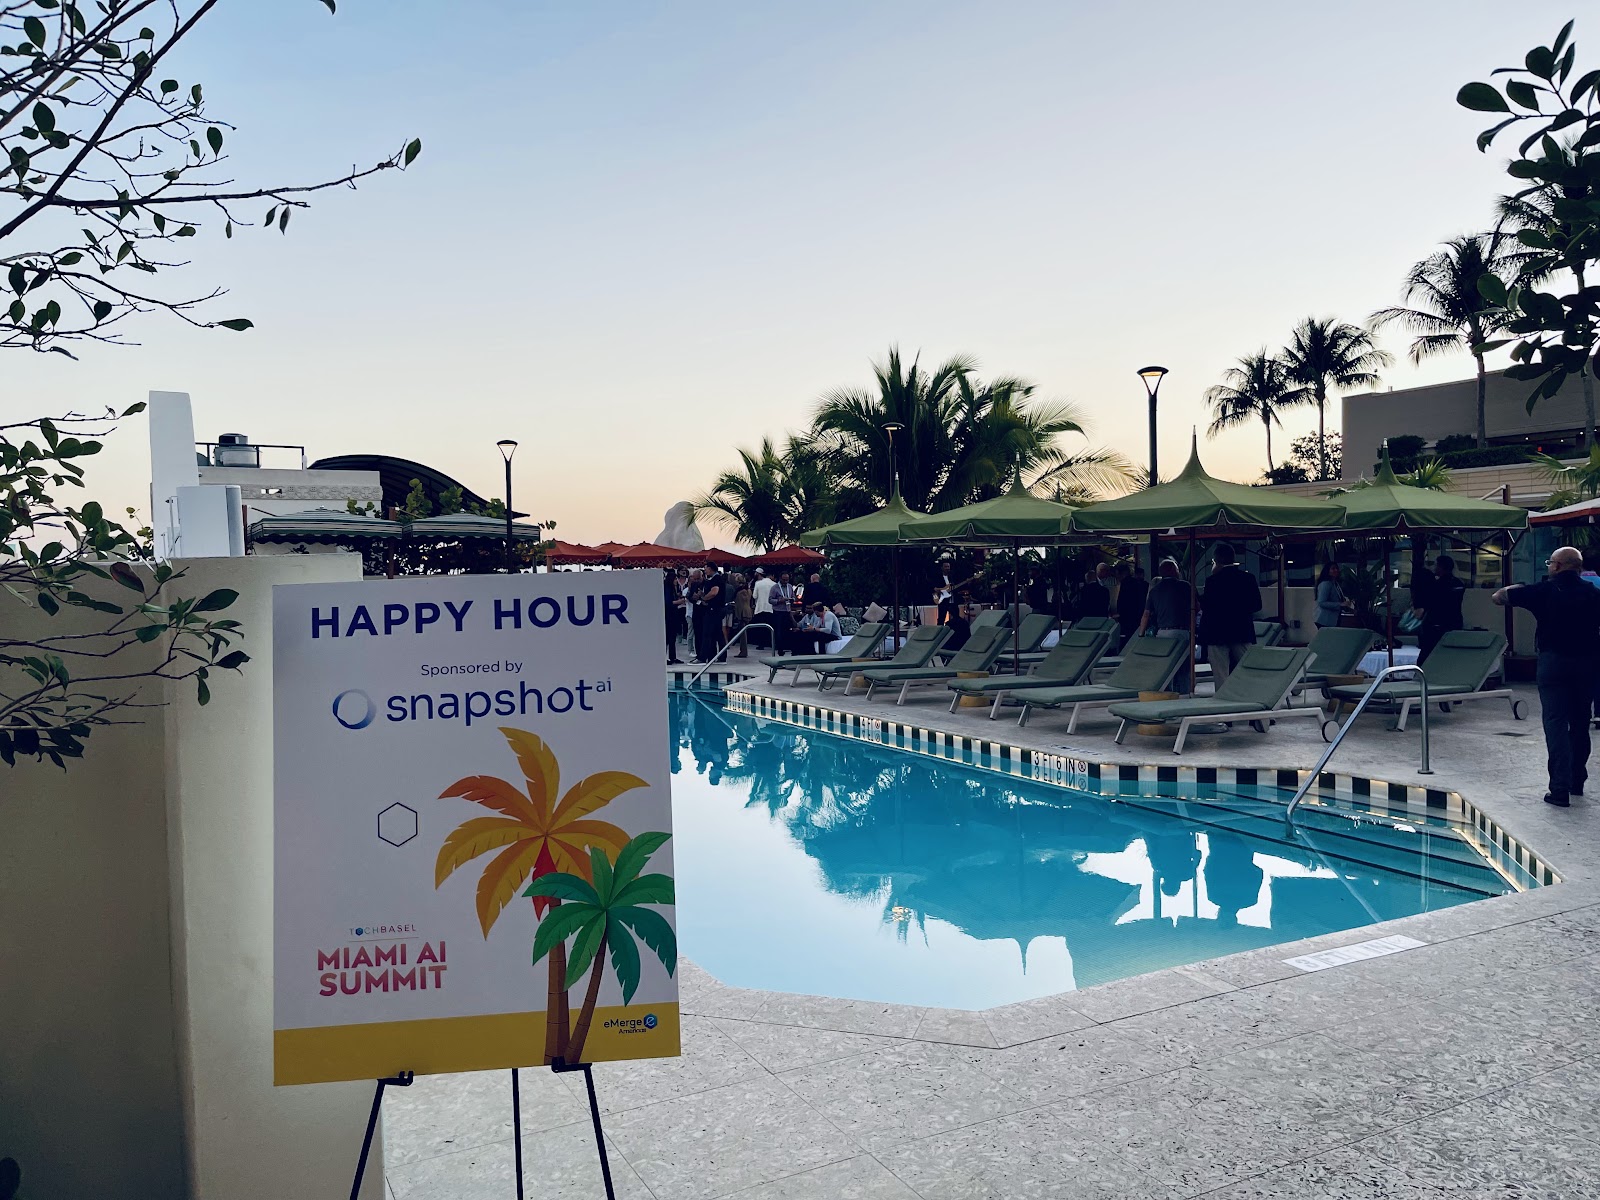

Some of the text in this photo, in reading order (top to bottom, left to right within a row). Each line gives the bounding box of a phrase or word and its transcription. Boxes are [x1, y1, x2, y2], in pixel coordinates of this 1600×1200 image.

[311, 594, 630, 638] HAPPY HOUR
[421, 660, 523, 677] Sponsored by
[386, 677, 612, 726] snapshot ai
[1034, 751, 1040, 766] 3
[1056, 756, 1062, 770] 6
[1065, 757, 1076, 774] IN
[317, 941, 446, 971] MIAMI AI
[319, 965, 447, 996] SUMMIT
[603, 1018, 643, 1029] eMerge
